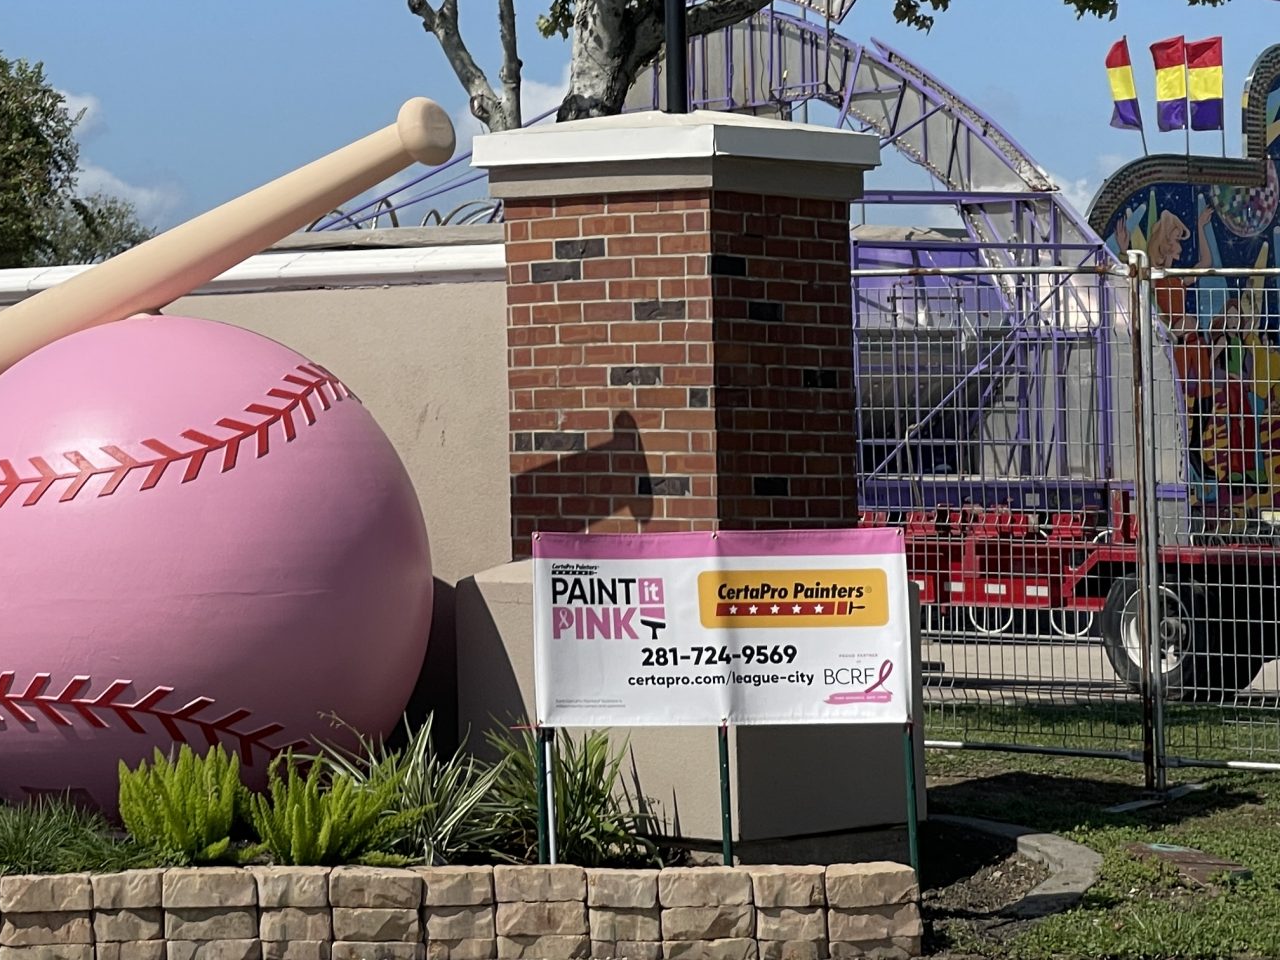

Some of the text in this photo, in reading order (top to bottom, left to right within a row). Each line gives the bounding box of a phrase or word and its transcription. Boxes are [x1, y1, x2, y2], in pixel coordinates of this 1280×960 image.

[551, 577, 659, 605] PAINT it
[717, 581, 864, 600] CertaPro Painters
[552, 607, 640, 640] PINK
[641, 644, 797, 667] 281-724-9569
[628, 670, 815, 688] certapro.com/league-city
[823, 668, 875, 685] BCRF
